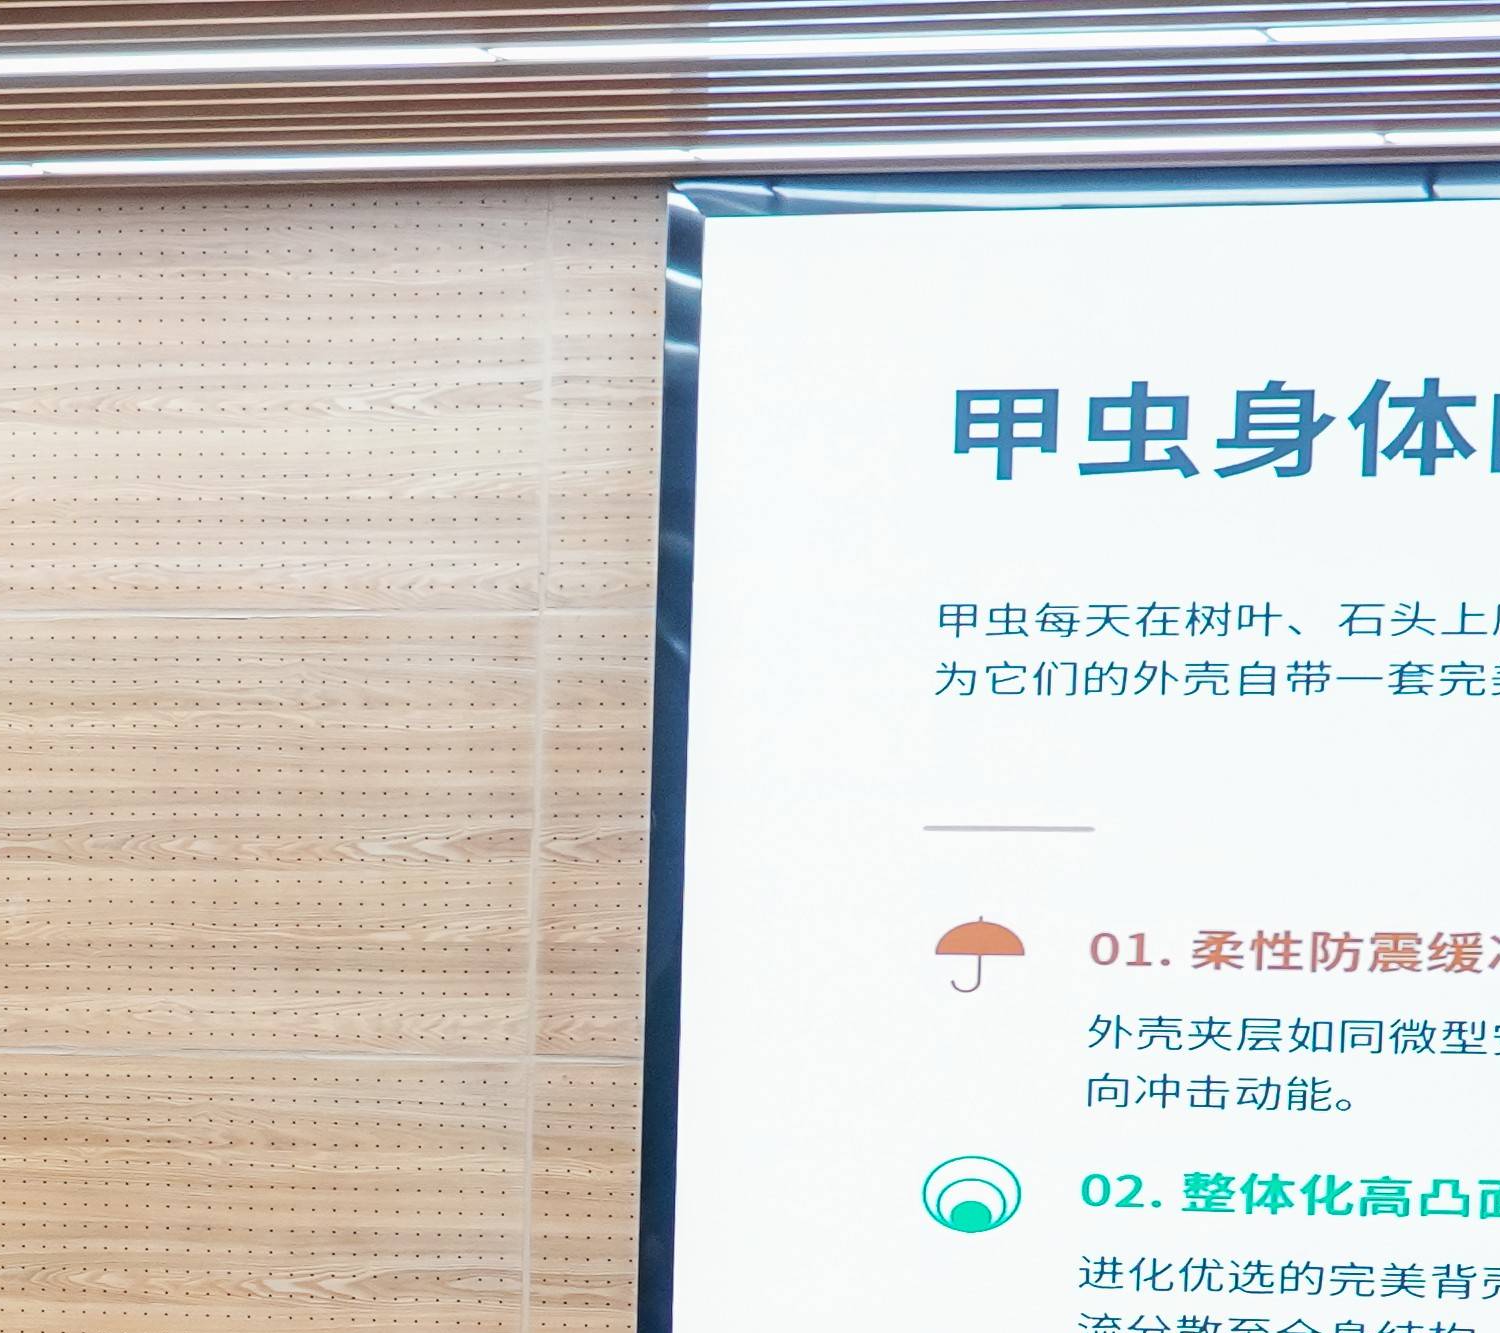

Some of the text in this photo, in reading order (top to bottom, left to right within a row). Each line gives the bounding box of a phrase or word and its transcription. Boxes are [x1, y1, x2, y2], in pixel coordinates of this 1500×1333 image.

[1091, 933, 1170, 966] 01.
[1088, 1072, 1351, 1111] 向冲击动能。
[1080, 1173, 1162, 1209] 02.
